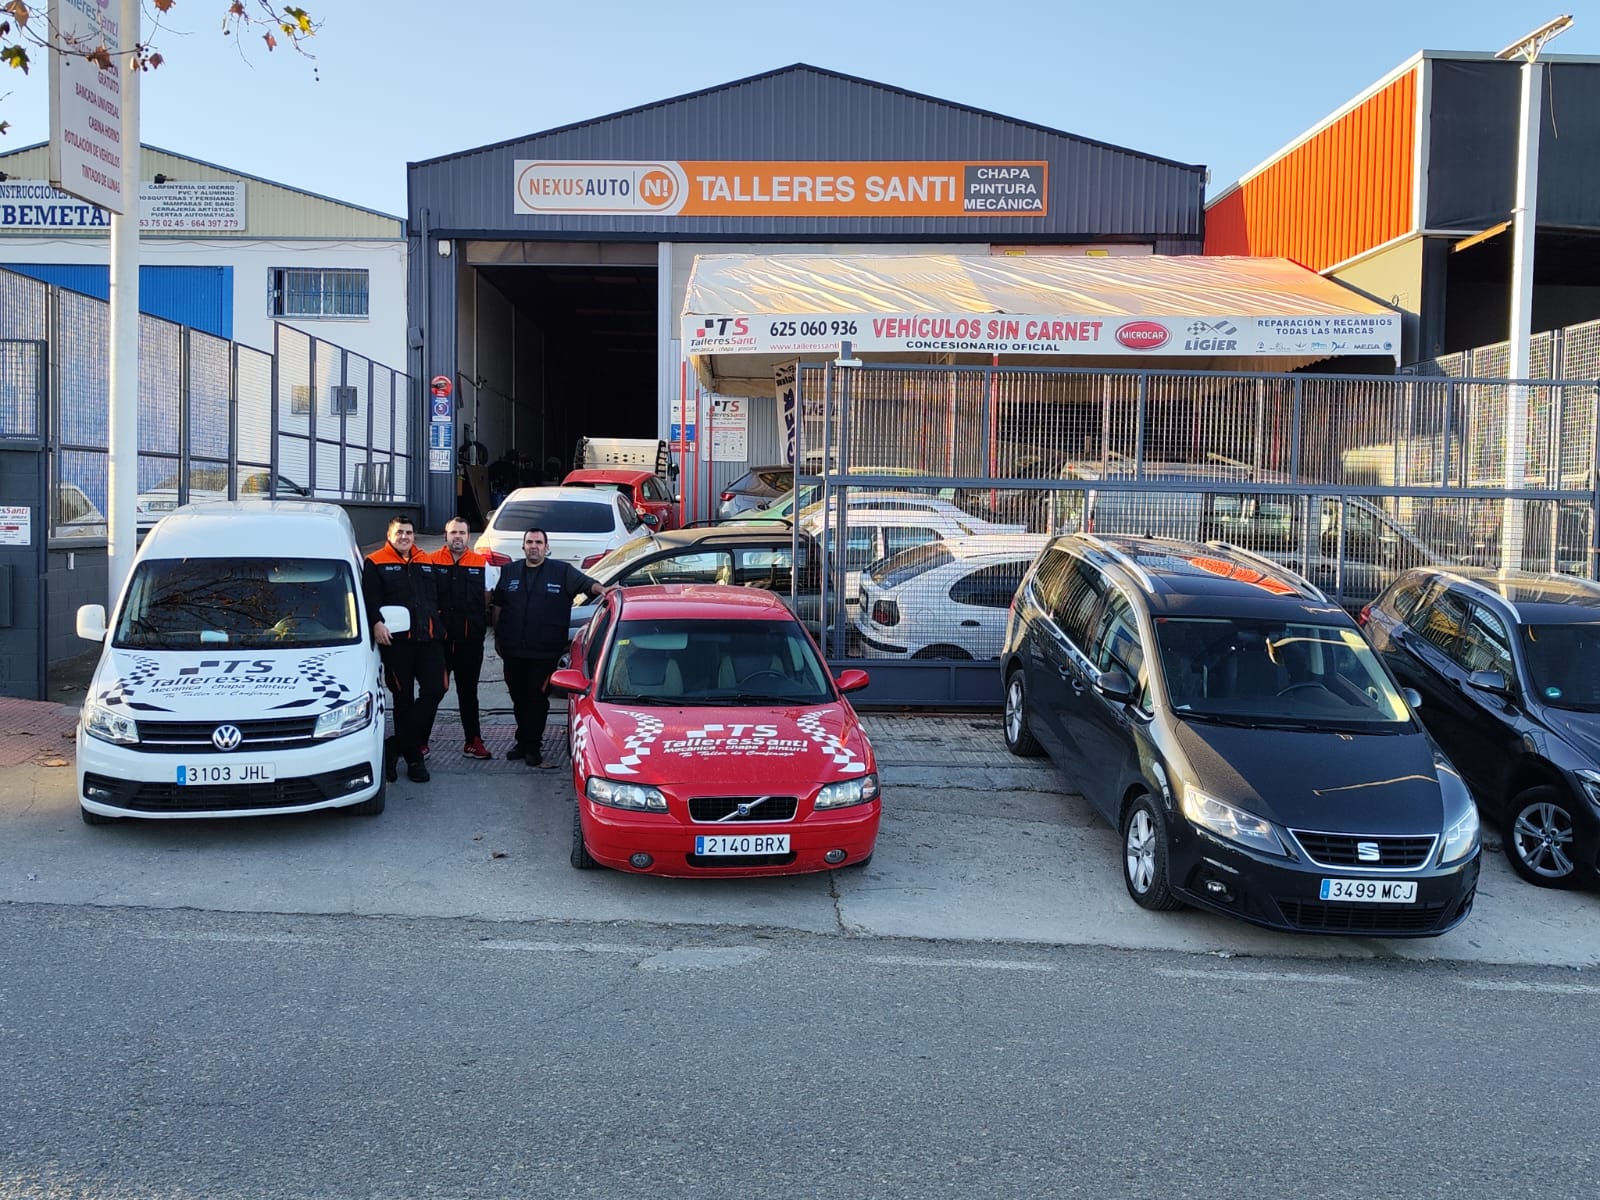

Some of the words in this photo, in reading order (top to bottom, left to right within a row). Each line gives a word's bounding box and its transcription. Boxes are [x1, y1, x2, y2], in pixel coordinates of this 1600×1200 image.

[76, 82, 97, 105] BANCADA
[98, 95, 120, 119] UNIVERSAL
[88, 116, 104, 136] CABINA
[105, 126, 120, 143] HORNO
[82, 164, 101, 186] TINTADO
[107, 177, 120, 193] LUNAS
[977, 168, 1031, 179] CHAPA
[529, 178, 630, 197] NEXUSAUTO
[696, 175, 856, 202] TALLERES
[865, 175, 956, 202] SANTI
[970, 183, 1037, 194] PINTURA
[964, 195, 1043, 210] MECÁNICA
[770, 321, 796, 336] 625
[800, 320, 827, 336] 060
[831, 320, 857, 335] 936
[872, 315, 982, 339] VEHÍCULOS
[987, 320, 1019, 340] SIN
[1025, 321, 1103, 342] CARNET
[1257, 318, 1321, 327] REPARACIÓN
[1121, 331, 1165, 339] MICROCAR
[906, 340, 1008, 350] CONCESIONARIO
[1012, 343, 1060, 351] OFICIAL
[223, 660, 276, 674] TS
[727, 724, 778, 737] TS
[188, 766, 231, 781] 3103
[239, 765, 270, 780] JHL
[708, 837, 750, 852] 2140
[754, 836, 785, 852] BRX
[1333, 882, 1377, 899] 3499
[1381, 884, 1414, 900] MCJ
